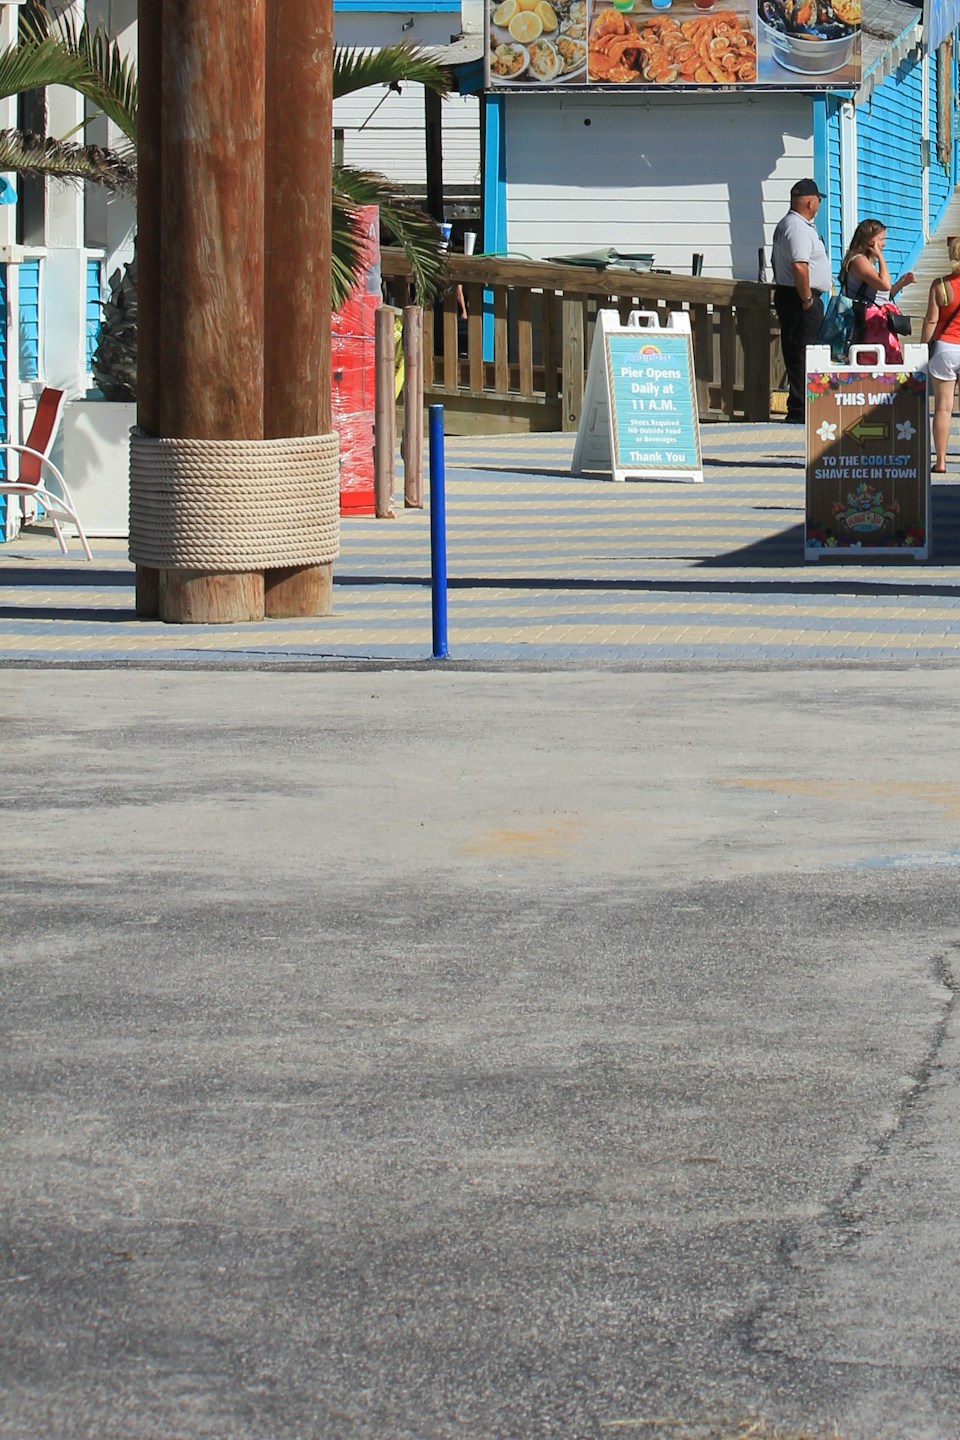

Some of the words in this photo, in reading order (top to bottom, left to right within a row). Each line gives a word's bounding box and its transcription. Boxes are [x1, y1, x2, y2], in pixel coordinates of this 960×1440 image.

[620, 366, 644, 378] Pier
[646, 367, 682, 381] Opens
[631, 382, 660, 397] Daily
[662, 383, 675, 394] at
[632, 399, 644, 410] 11
[648, 399, 677, 411] A.M.
[834, 392, 866, 406] THIS
[867, 392, 898, 406] WAY
[630, 418, 650, 426] Shoes
[651, 419, 680, 427] Required
[644, 436, 677, 444] Beverages
[629, 450, 663, 462] Thank
[664, 451, 687, 463] You
[822, 455, 837, 466] TO
[839, 455, 860, 466] THE
[860, 455, 911, 466] COOLEST
[814, 468, 850, 479] SHAVE
[852, 468, 869, 479] ICE
[870, 468, 883, 479] IN
[884, 468, 917, 479] TOWN
